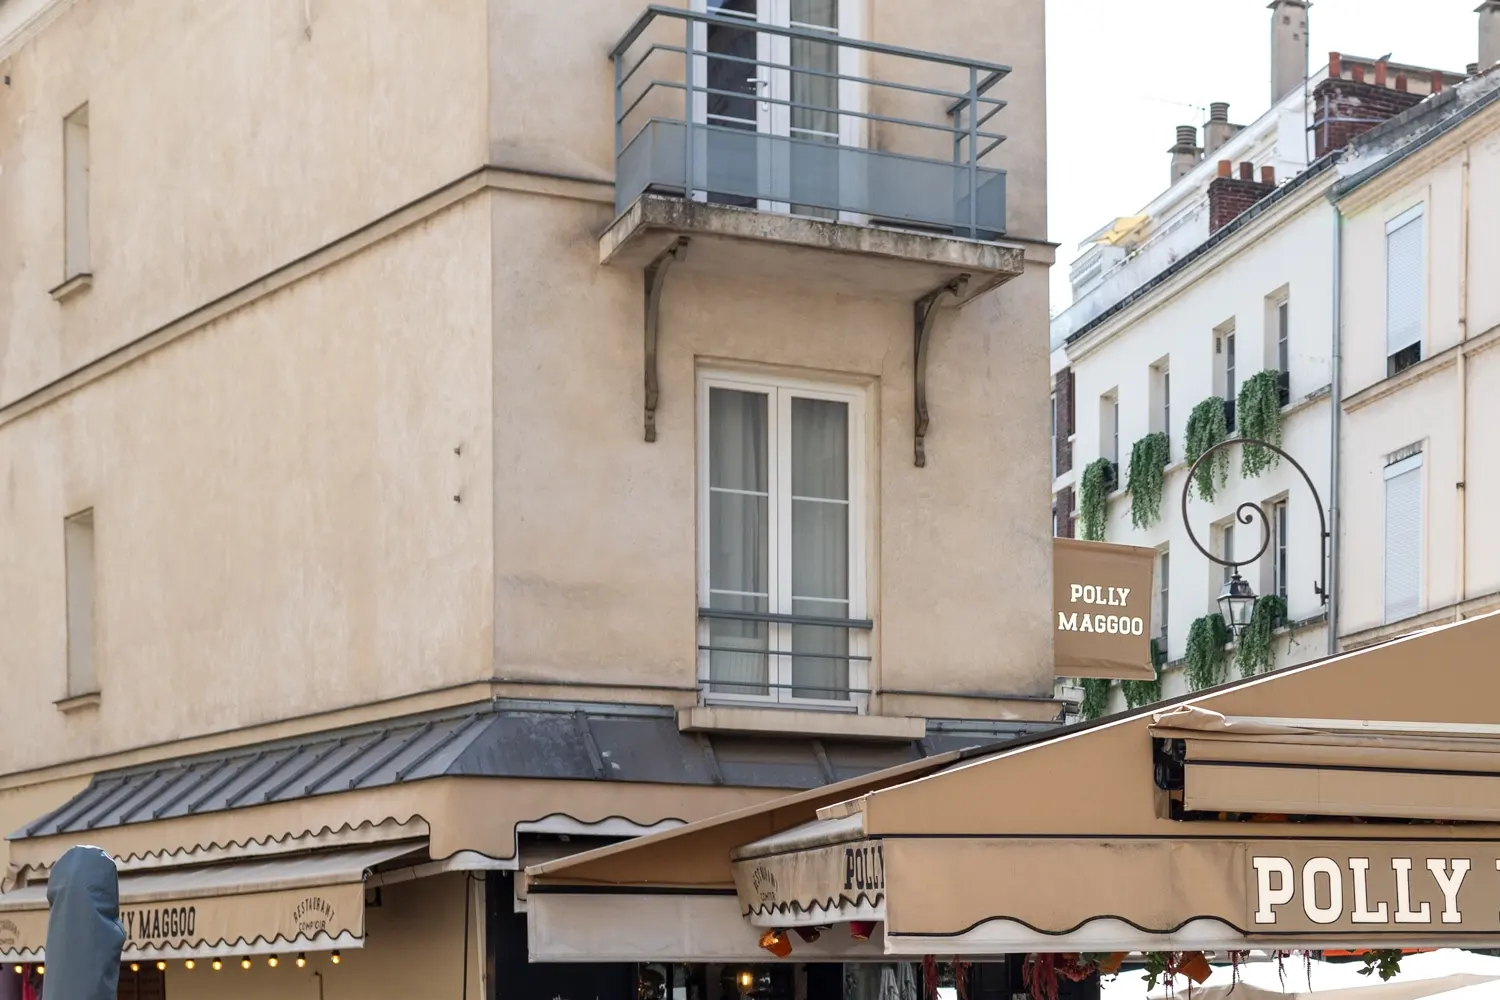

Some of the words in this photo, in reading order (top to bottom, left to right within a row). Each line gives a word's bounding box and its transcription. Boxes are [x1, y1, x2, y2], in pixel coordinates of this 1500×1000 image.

[1070, 584, 1131, 607] POLLY
[1058, 612, 1143, 636] MAGGOO
[1252, 856, 1471, 924] POLLY
[138, 906, 197, 940] MAGGOO
[293, 896, 335, 923] RESTAURANT
